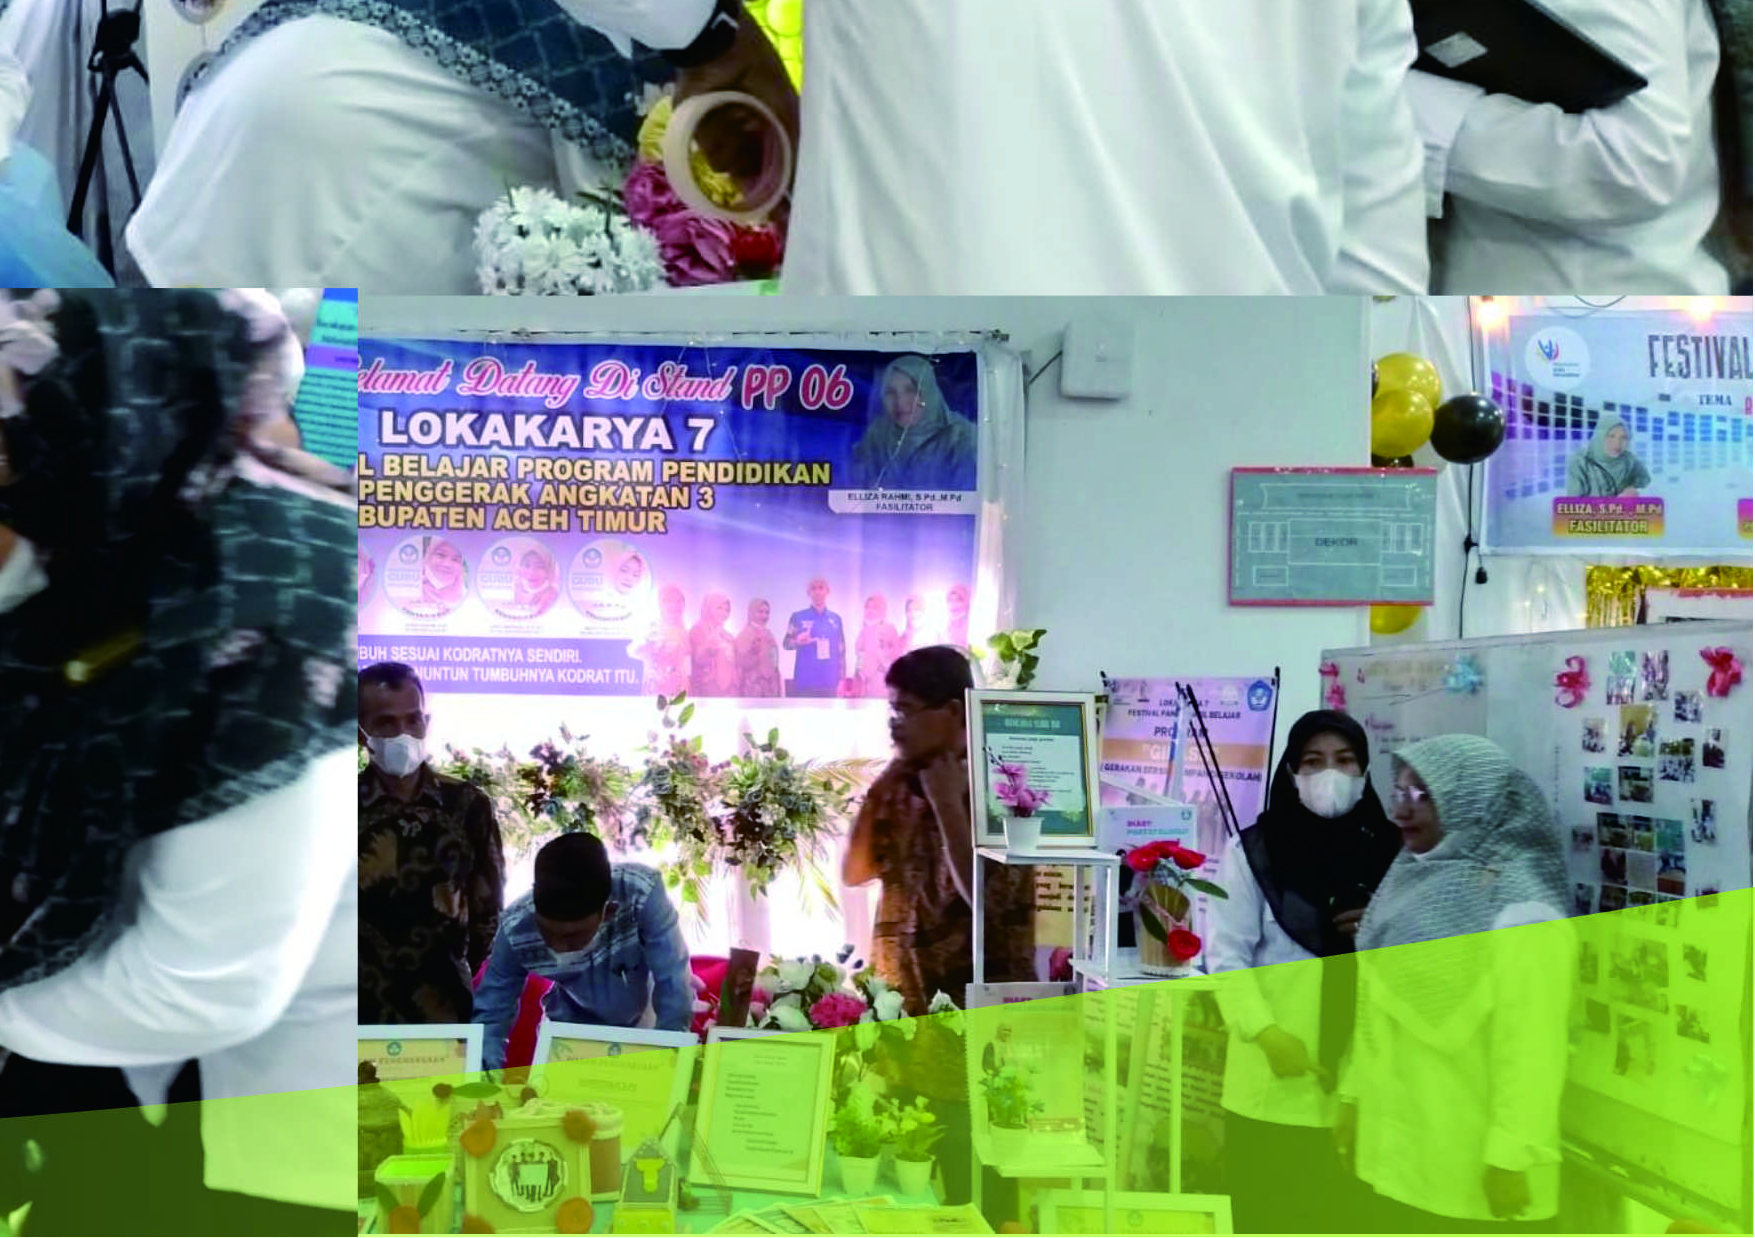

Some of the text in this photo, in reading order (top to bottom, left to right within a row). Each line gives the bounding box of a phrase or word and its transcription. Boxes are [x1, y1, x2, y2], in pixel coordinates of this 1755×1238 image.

[458, 356, 580, 409] Datang
[584, 358, 642, 401] Di
[642, 356, 737, 402] Stand
[741, 365, 793, 409] PP
[799, 364, 854, 410] 06
[1698, 394, 1733, 407] TEMA
[381, 411, 715, 452] LOKAKARYA 7
[384, 456, 509, 480] BELAJAR
[516, 459, 654, 483] PROGRAM
[662, 461, 831, 486] PENDIDIKAN
[358, 479, 714, 510] PENGGERAK ANGKATAN 3
[875, 502, 934, 512] FASILITATOR
[358, 505, 667, 534] BUPATEN ACEH TIMUR
[1568, 519, 1650, 535] FASILITATOR
[390, 646, 441, 662] SESUAI
[442, 647, 524, 663] KODRATNYA
[526, 648, 583, 664] SENDIRI.
[472, 666, 555, 683] TUMBUHNYA
[557, 668, 612, 684] KODRAT
[613, 669, 640, 685] ITU.
